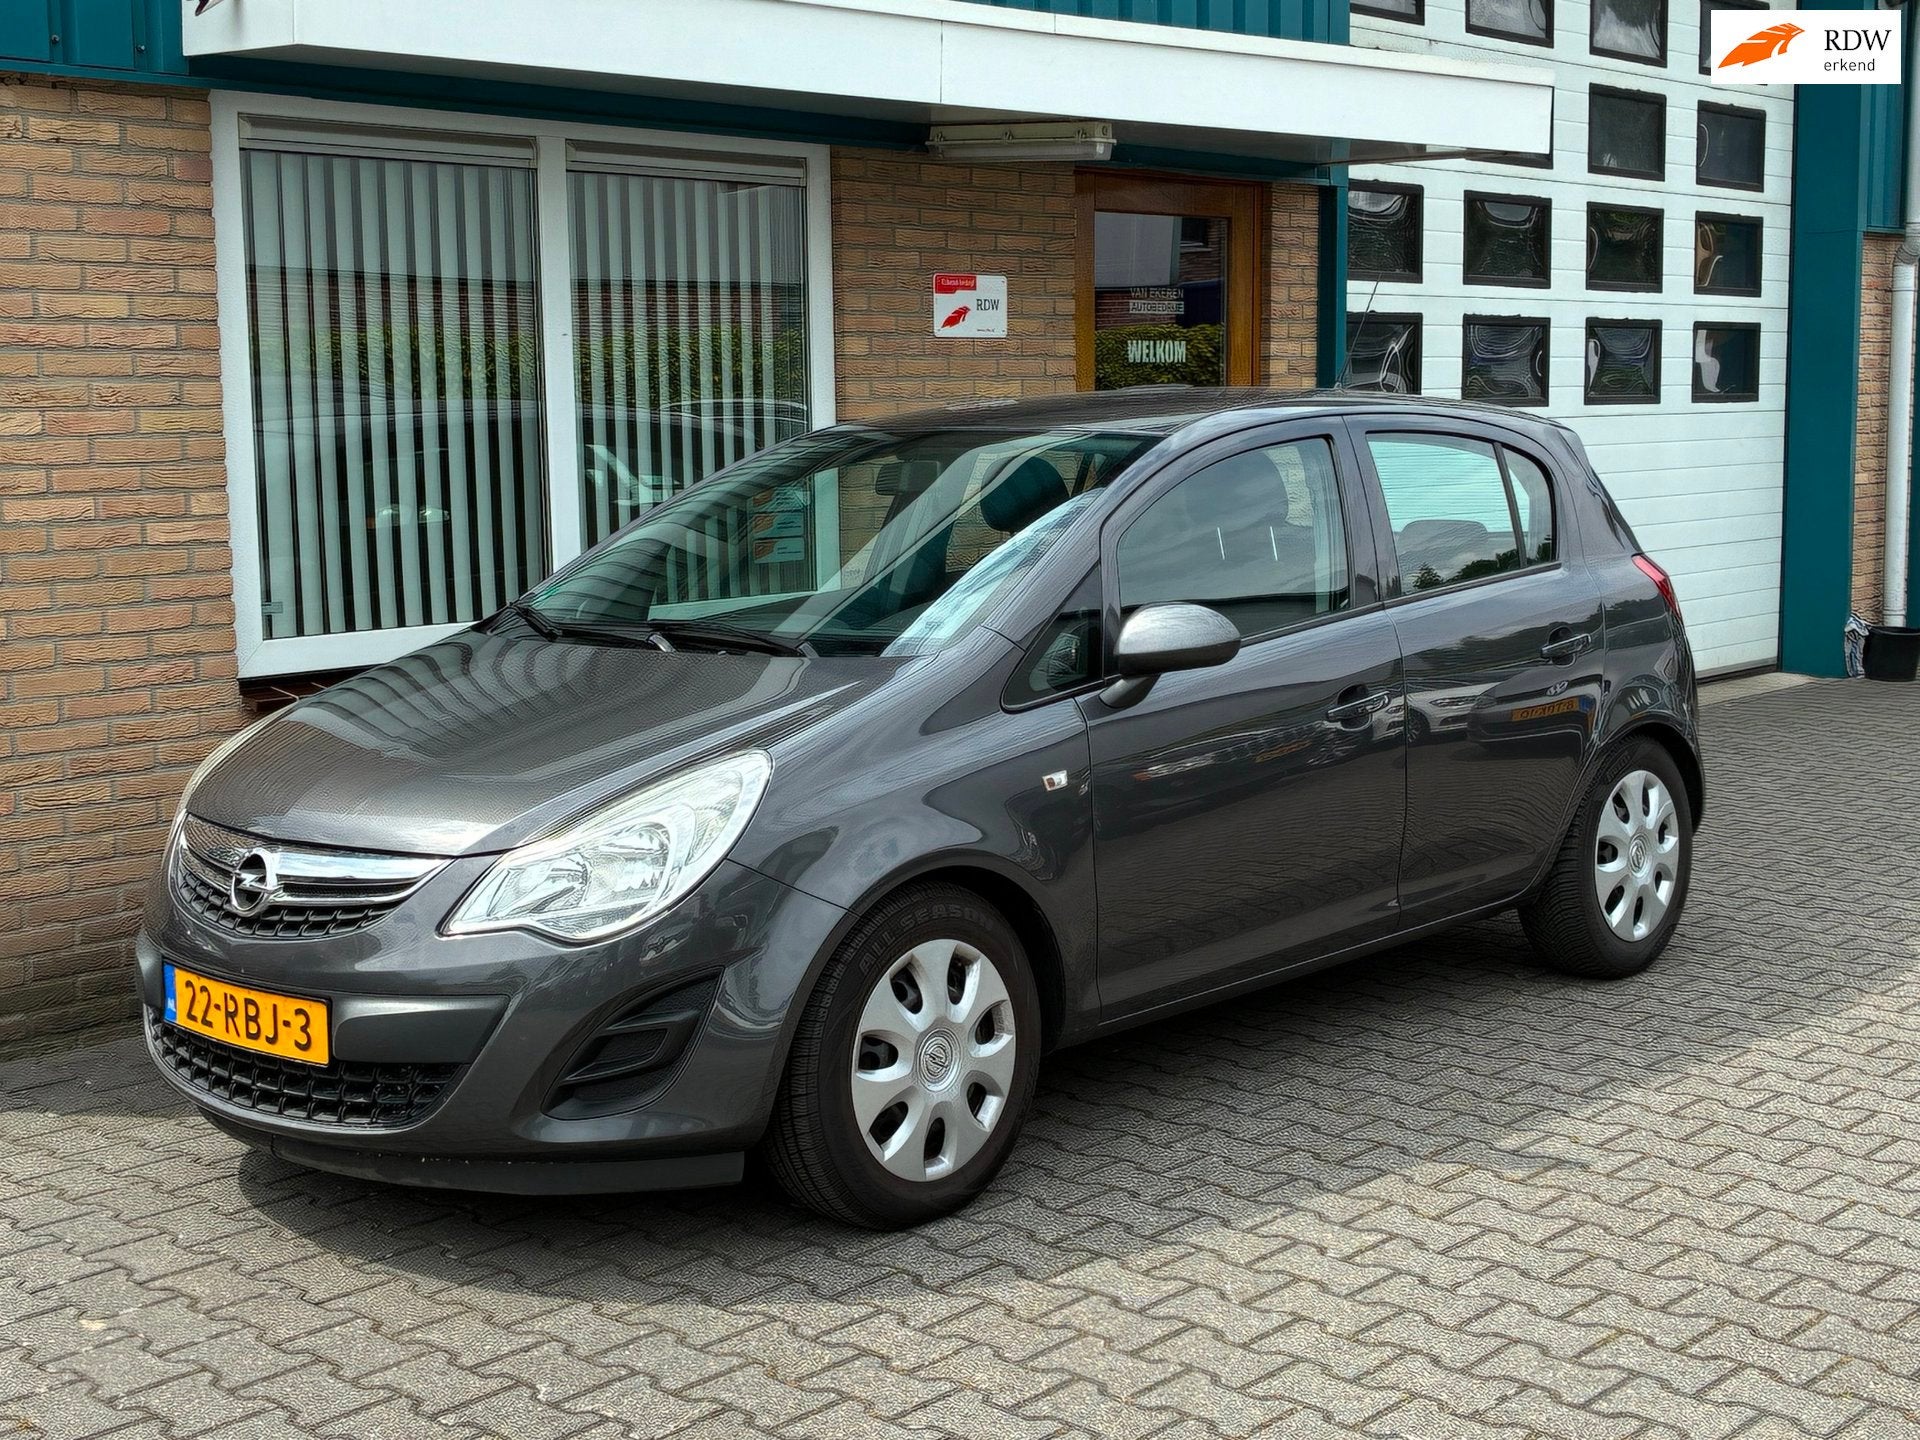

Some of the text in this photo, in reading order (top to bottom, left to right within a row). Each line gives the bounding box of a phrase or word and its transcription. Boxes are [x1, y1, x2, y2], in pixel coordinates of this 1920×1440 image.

[976, 298, 1000, 311] RDW
[1130, 287, 1147, 299] VAN
[1127, 340, 1186, 363] WELKOM
[859, 903, 994, 973] ALL SEASON
[184, 979, 312, 1052] 22-RBJ-3
